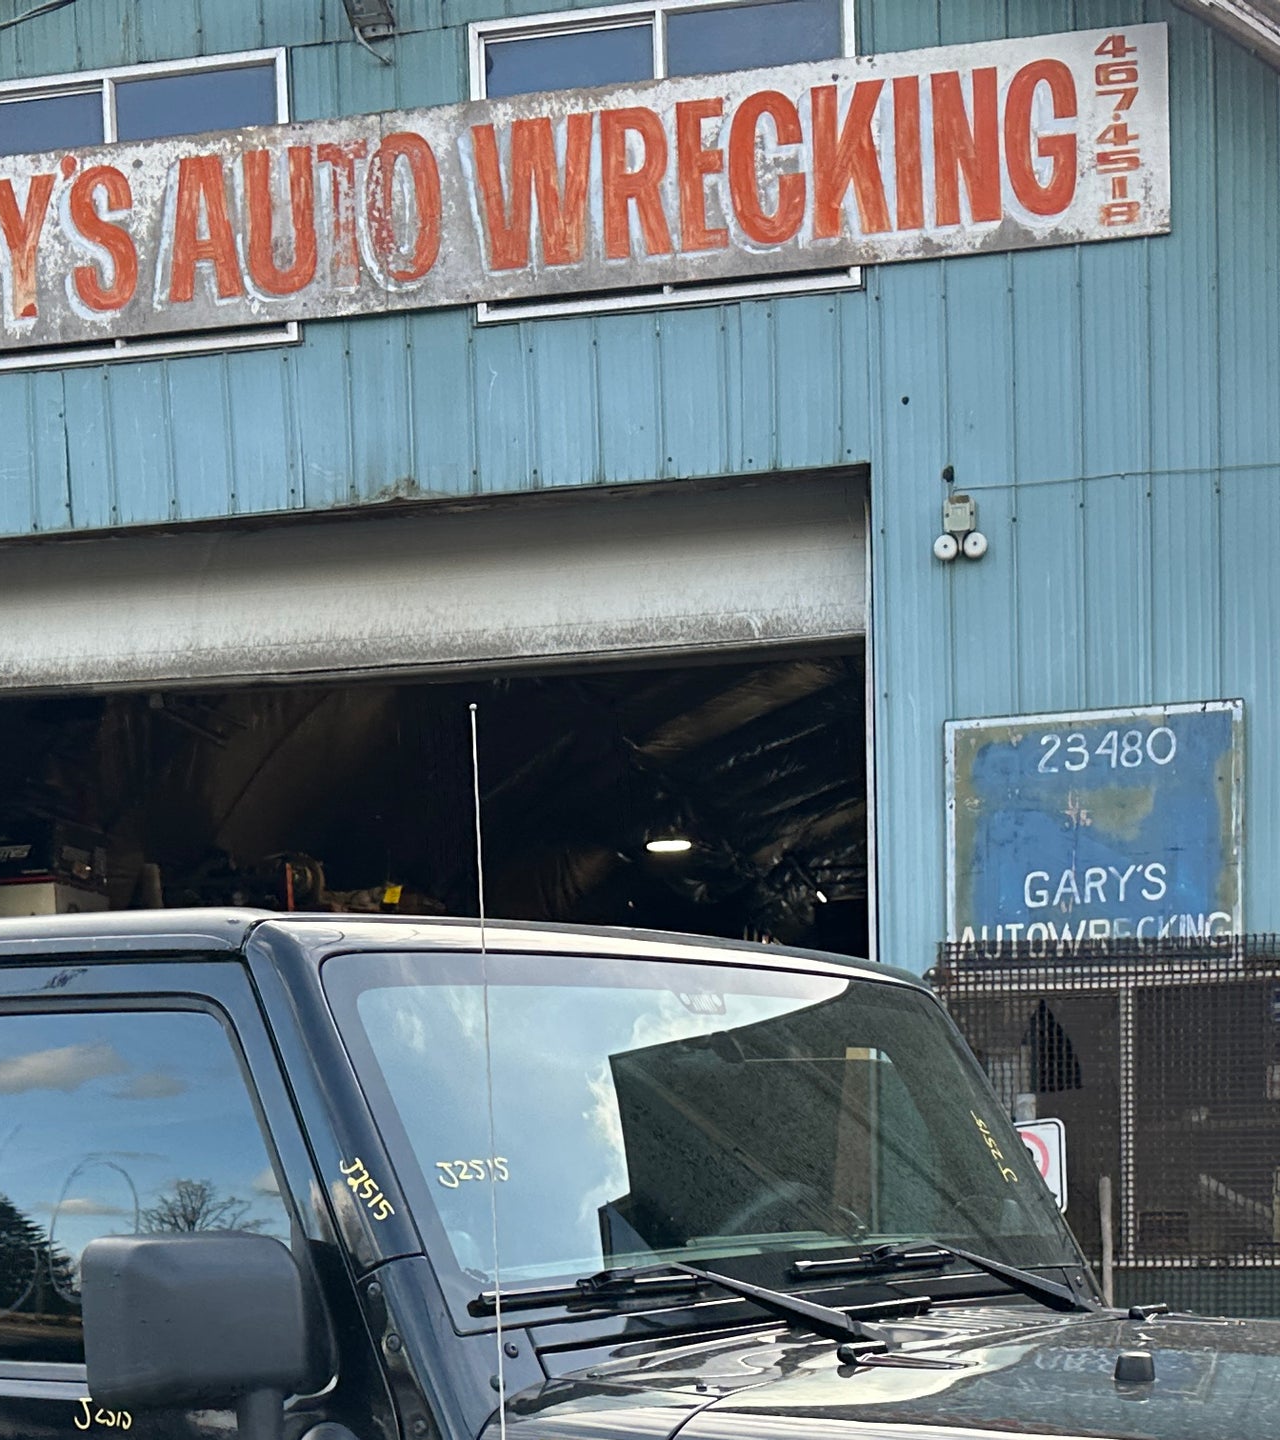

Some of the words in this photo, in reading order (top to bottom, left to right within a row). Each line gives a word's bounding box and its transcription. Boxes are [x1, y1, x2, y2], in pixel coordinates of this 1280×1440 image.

[168, 131, 442, 303] AUTO
[471, 58, 1078, 271] WRECKING
[1038, 727, 1177, 773] 23480
[1024, 863, 1168, 908] GARY'S
[340, 1157, 396, 1222] J2515
[436, 1157, 509, 1188] J2515
